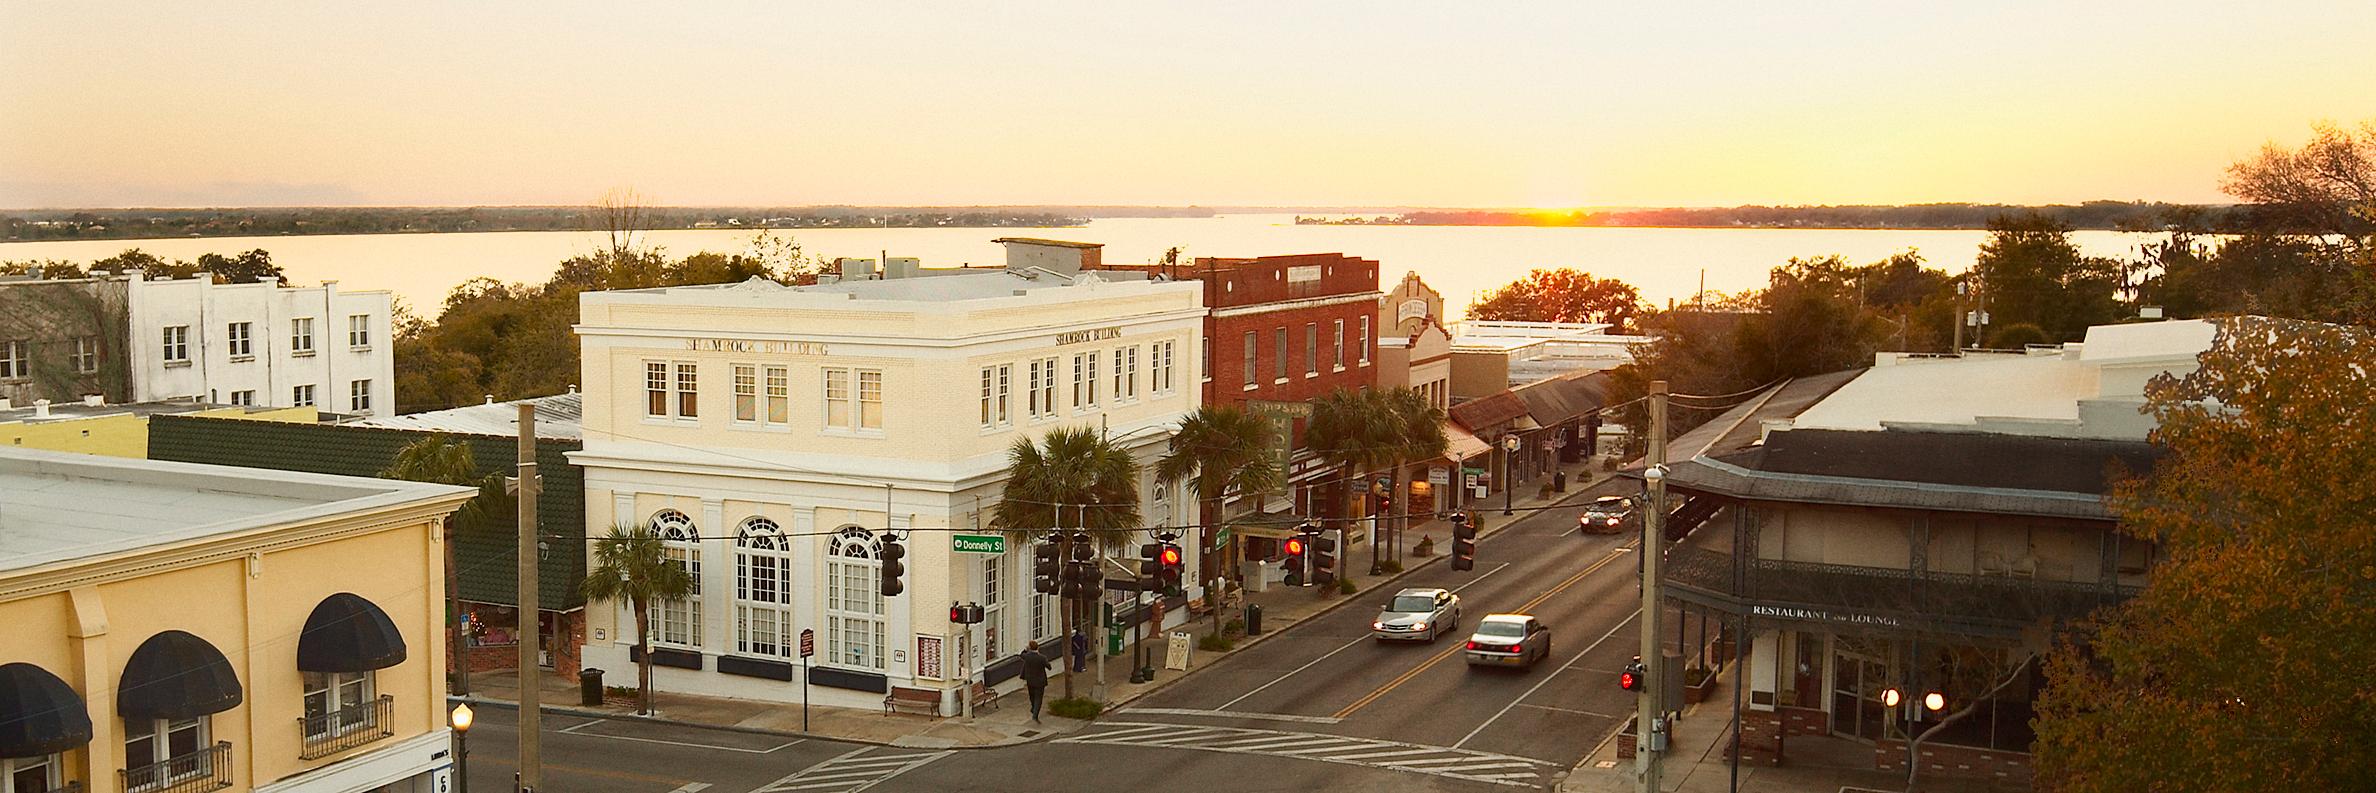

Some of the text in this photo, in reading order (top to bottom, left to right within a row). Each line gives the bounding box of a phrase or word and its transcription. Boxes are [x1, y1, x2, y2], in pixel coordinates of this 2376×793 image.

[686, 339, 828, 355] SHAMROCK BUILDING
[963, 540, 1003, 552] Donnelly St
[1753, 605, 1829, 620] RESTAURANT
[1851, 613, 1899, 626] LOUNGE
